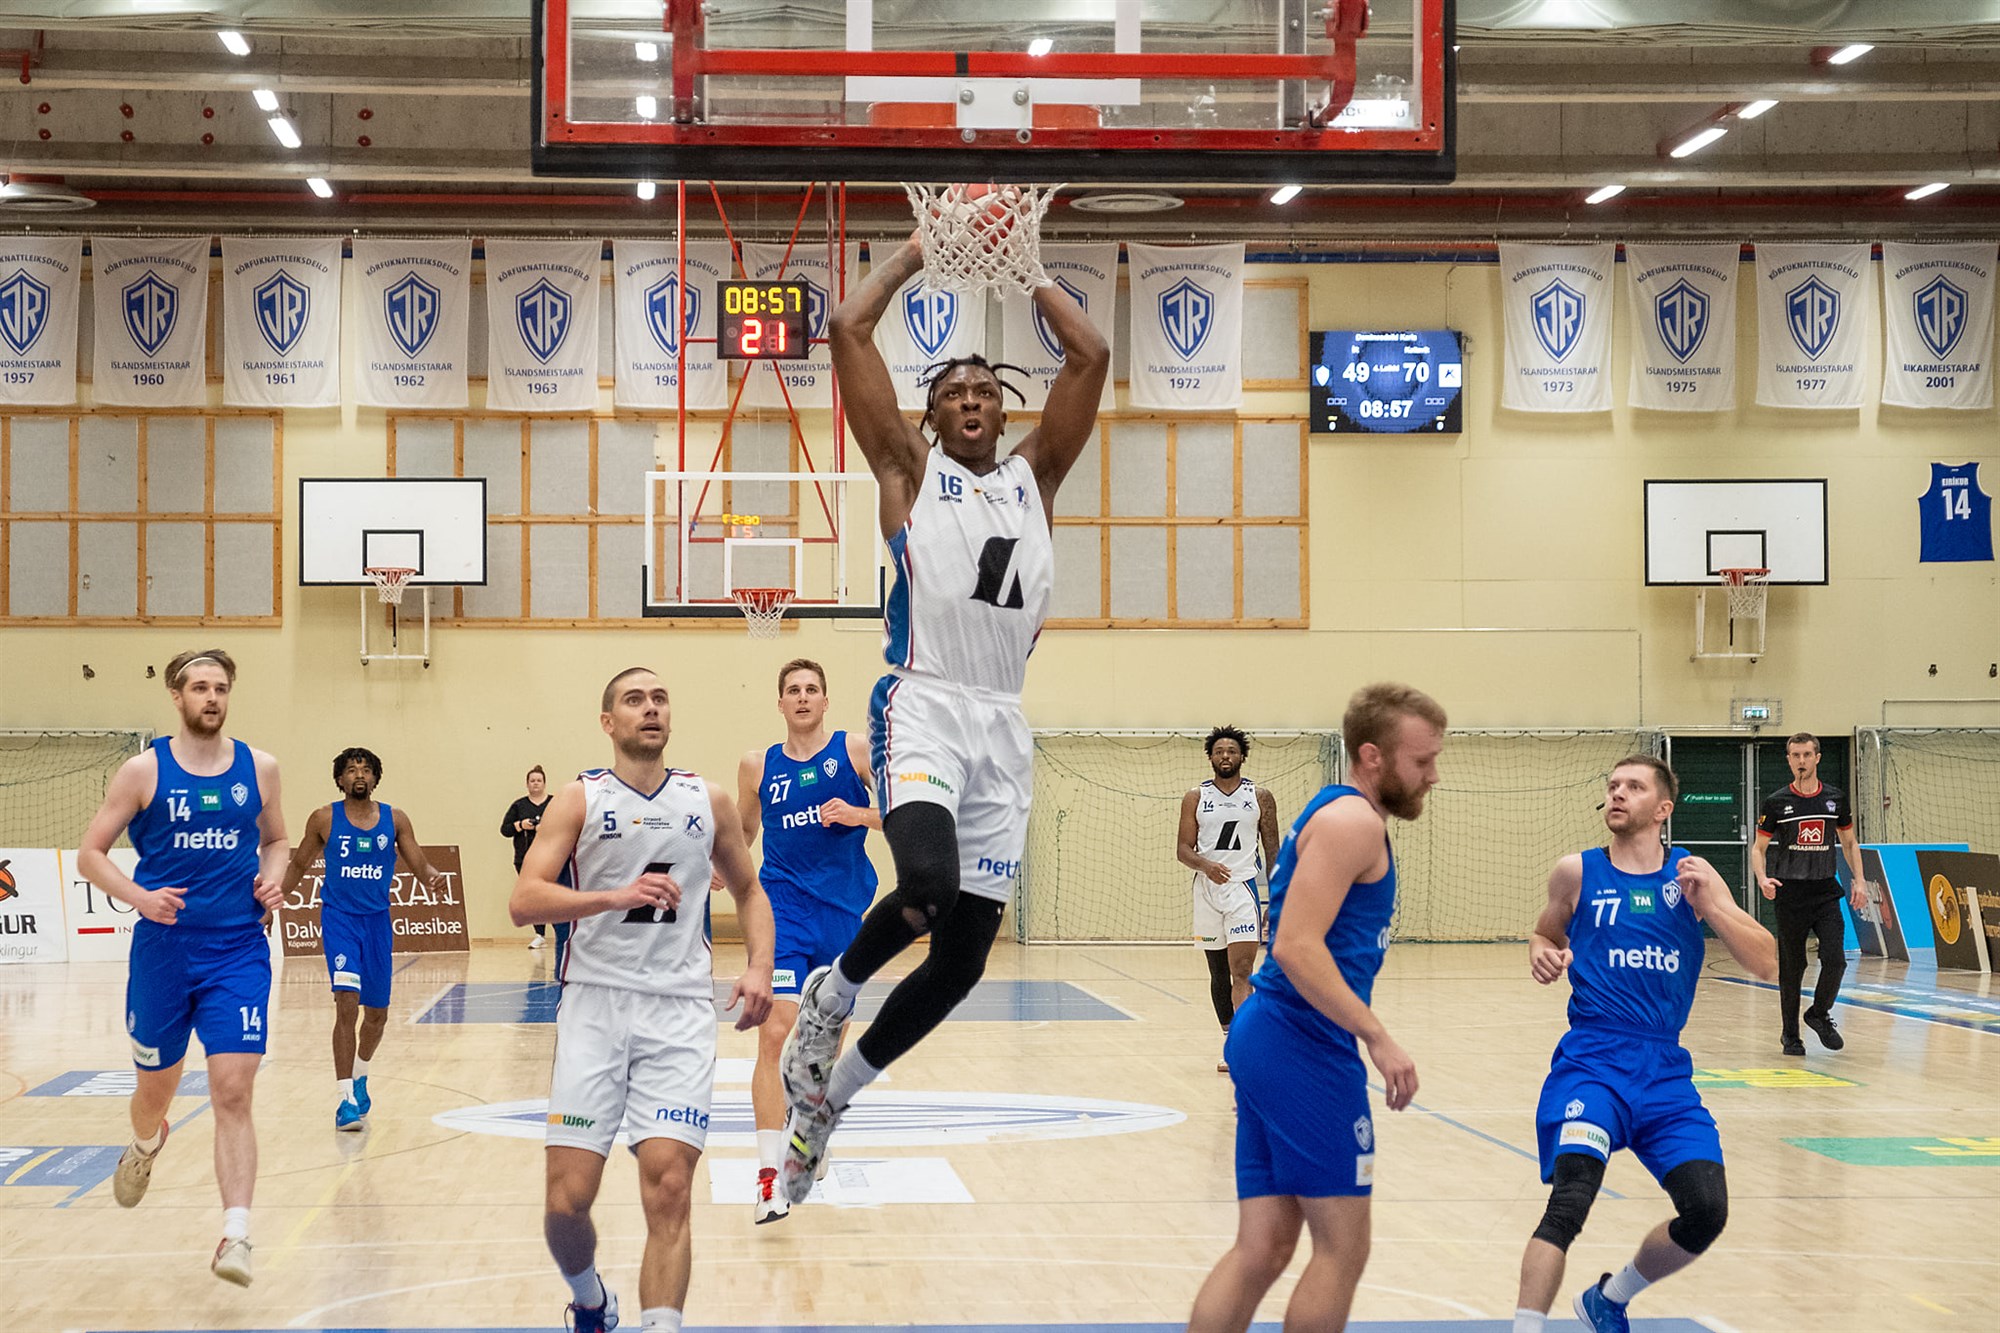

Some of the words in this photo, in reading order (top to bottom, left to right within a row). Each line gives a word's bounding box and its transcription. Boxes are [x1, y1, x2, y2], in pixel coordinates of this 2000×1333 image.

[725, 287, 801, 315] 08:57
[741, 319, 787, 355] 21
[3, 372, 34, 384] 1957
[1342, 362, 1370, 382] 49
[1403, 362, 1430, 382] 70
[133, 374, 164, 386] 1960
[265, 374, 296, 385] 1961
[394, 376, 425, 387] 1962
[655, 375, 677, 386] 196
[784, 376, 815, 387] 1969
[1169, 378, 1200, 389] 1972
[1796, 379, 1827, 390] 1977
[1926, 377, 1955, 388] 2001
[527, 383, 557, 394] 1963
[1543, 381, 1574, 392] 1973
[1666, 381, 1697, 392] 1975
[1359, 400, 1413, 418] 08:57
[938, 472, 963, 496] 16
[1942, 488, 1971, 520] 14
[801, 771, 815, 781] TM
[769, 779, 792, 805] 27
[202, 795, 218, 804] TM
[1203, 800, 1214, 809] 14
[166, 796, 191, 822] 14
[604, 810, 617, 831] 5
[782, 805, 822, 829] nett
[340, 840, 349, 858] 5
[1633, 896, 1651, 906] TM
[1591, 898, 1621, 928] 77
[286, 921, 322, 939] Dalv
[239, 1006, 262, 1032] 14
